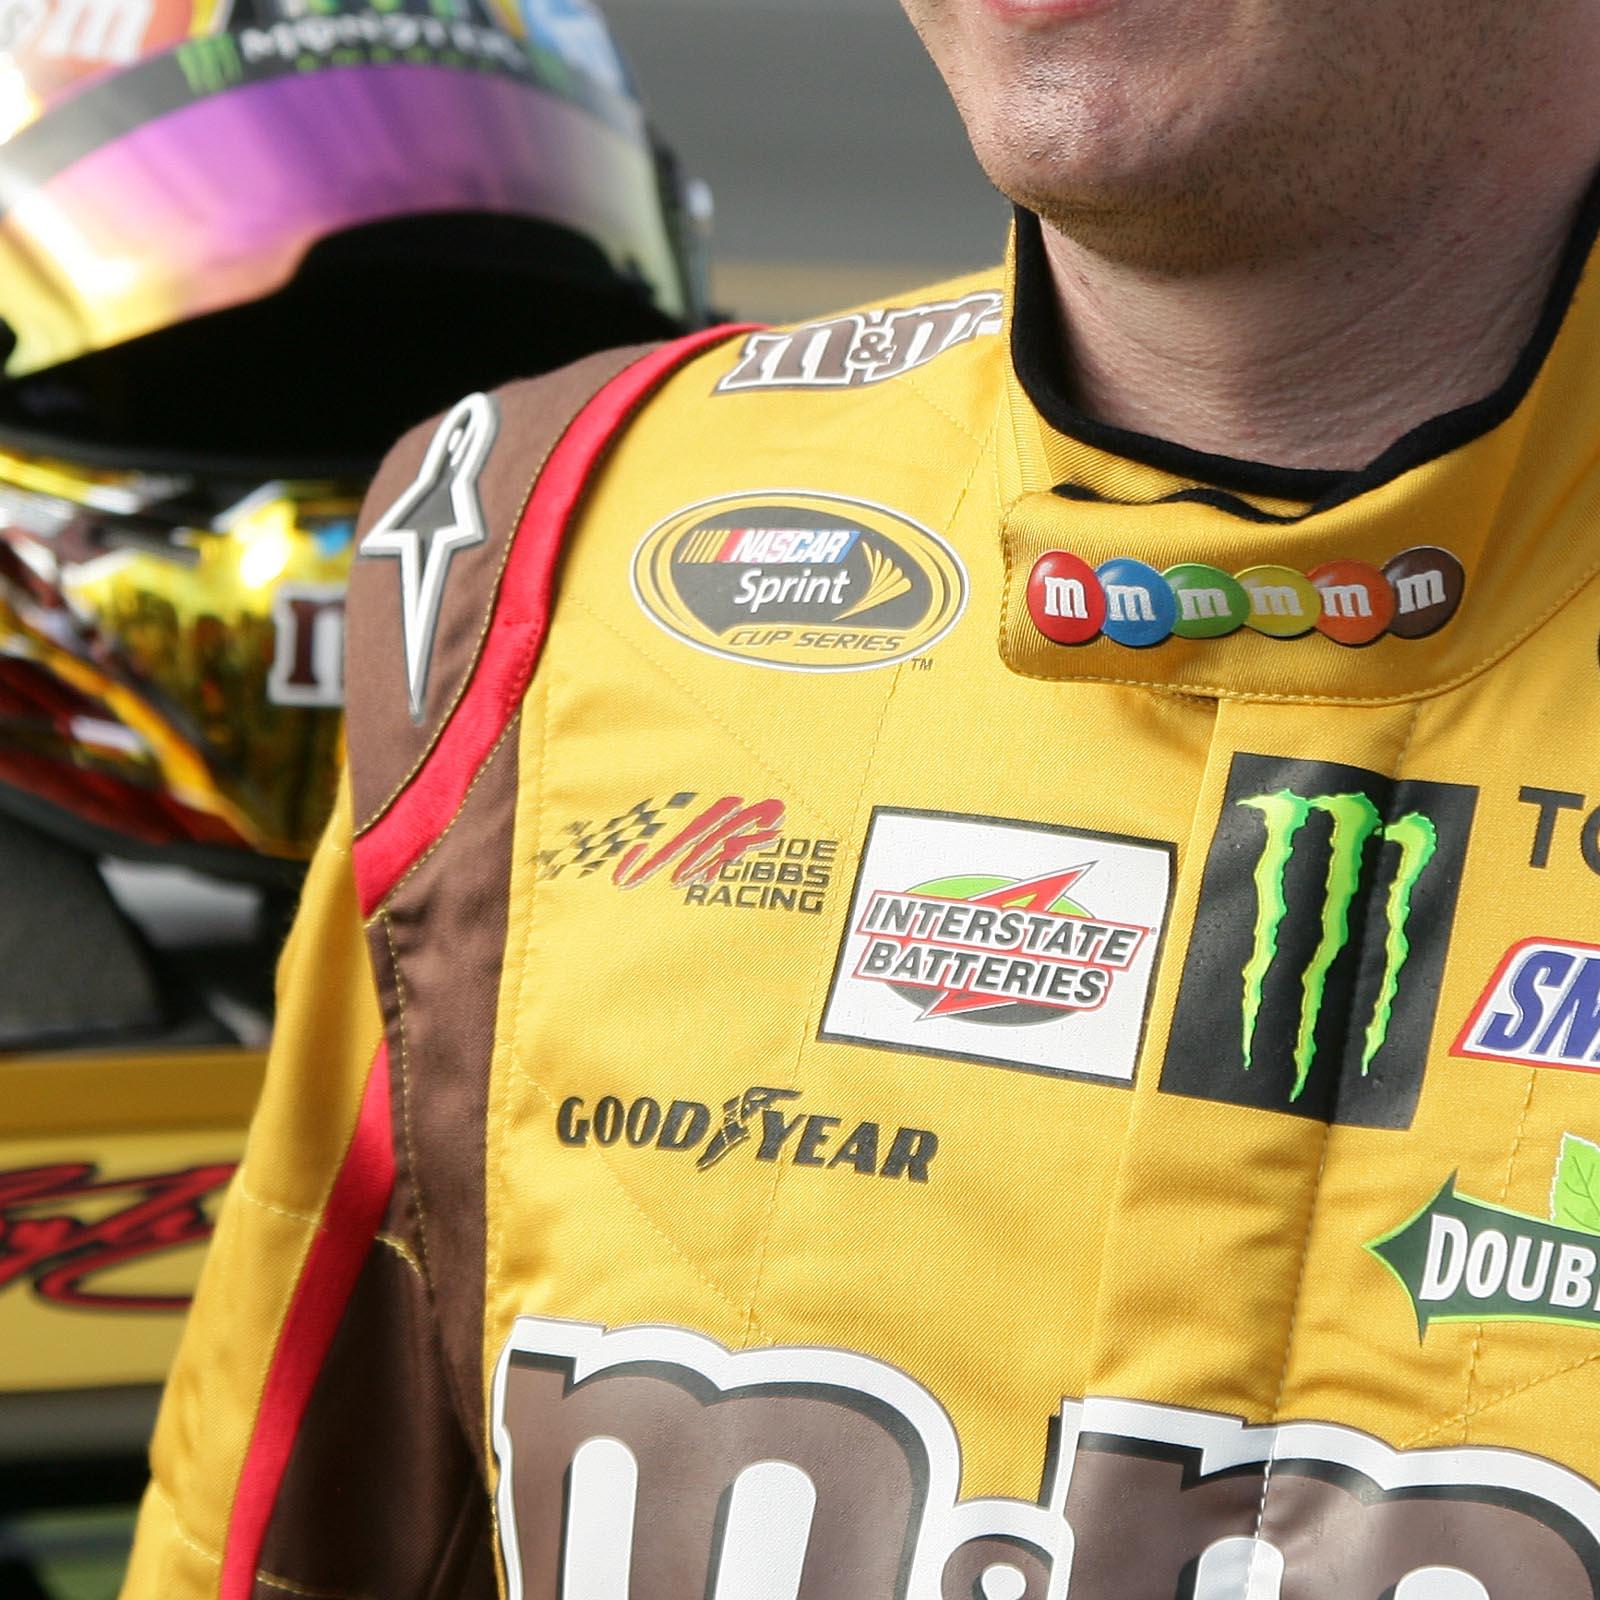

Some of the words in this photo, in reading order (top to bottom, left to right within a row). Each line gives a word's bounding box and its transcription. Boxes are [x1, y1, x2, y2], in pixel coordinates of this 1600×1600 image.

[730, 530, 849, 564] NASCAR
[734, 567, 852, 614] Sprint
[1043, 576, 1089, 620] m
[1105, 584, 1157, 621] m
[1176, 588, 1232, 620] m
[1252, 585, 1304, 617] m
[1320, 583, 1372, 618] m
[1396, 569, 1446, 614] m
[727, 630, 791, 647] CUP
[793, 631, 906, 652] SERIES
[757, 838, 838, 862] JOE
[718, 860, 833, 889] GIBBS
[683, 884, 827, 915] RACING
[864, 896, 1138, 964] INTERSTATE
[861, 941, 1107, 1004] BATTERIES
